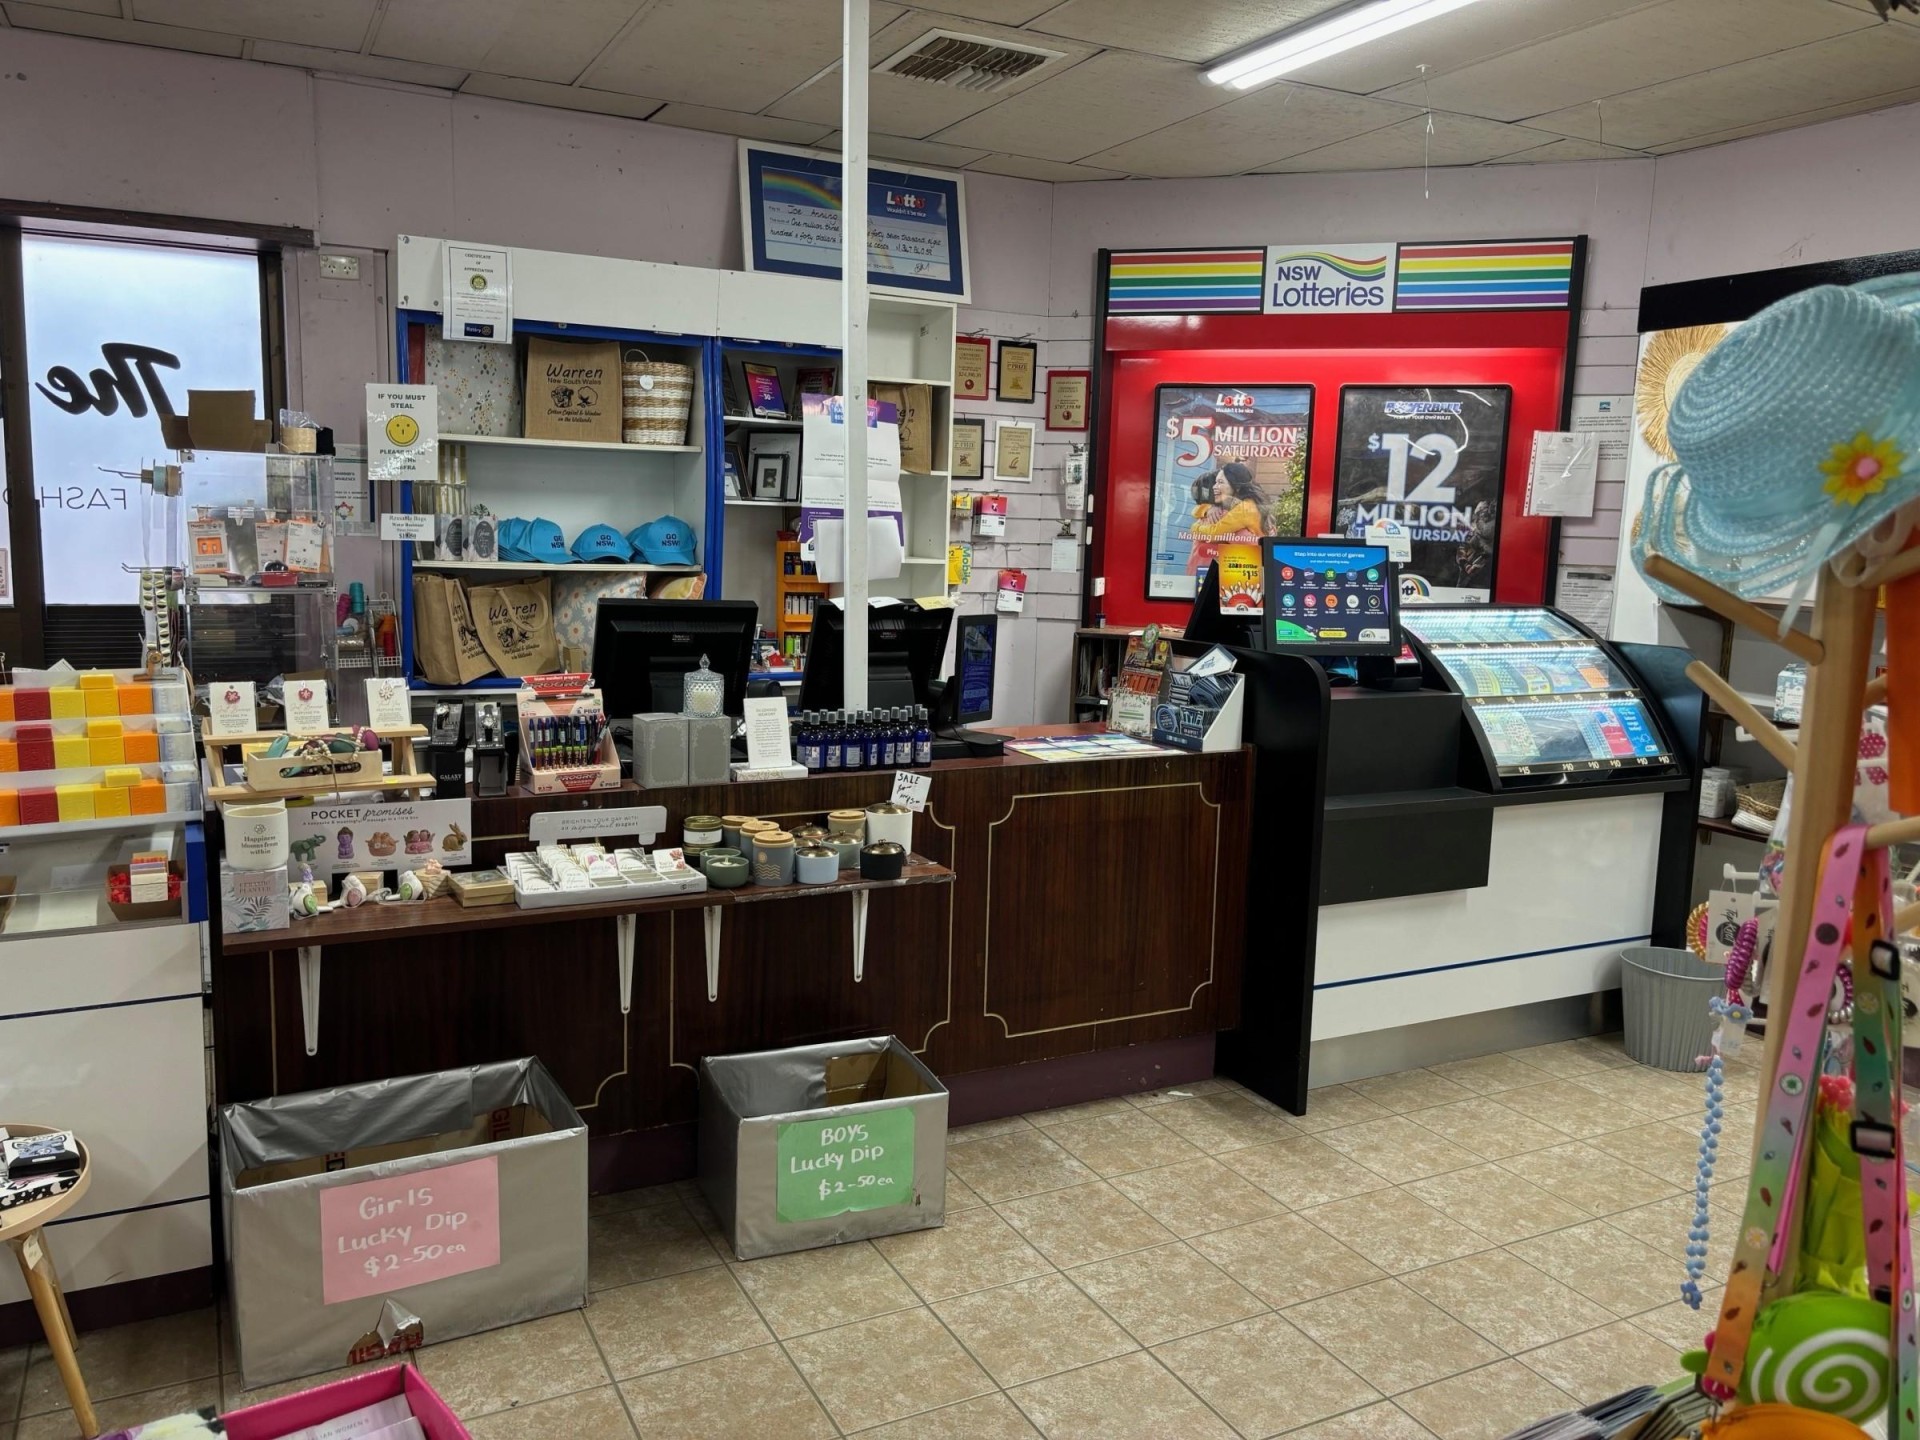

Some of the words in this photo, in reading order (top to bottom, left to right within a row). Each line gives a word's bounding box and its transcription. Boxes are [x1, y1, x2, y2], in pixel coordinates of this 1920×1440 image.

[886, 191, 925, 209] Lotto
[1278, 265, 1322, 281] NSW
[1272, 282, 1384, 307] Lotteries
[546, 363, 603, 379] Warren
[1216, 393, 1255, 407] Lotto
[1384, 401, 1462, 414] POWERBALL
[1166, 416, 1214, 467] $5
[1214, 426, 1297, 444] MILLION
[1214, 445, 1296, 458] SATURDAYS
[1368, 432, 1459, 504] $12
[1356, 503, 1472, 527] MILLION
[1177, 532, 1212, 543] Making
[1411, 528, 1469, 542] URSDAY
[962, 545, 971, 585] Mobile
[1588, 761, 1600, 769] $10
[1610, 760, 1621, 768] $10
[1637, 757, 1648, 765] $10
[1658, 755, 1670, 764] $10
[1518, 766, 1530, 775] $15
[1562, 763, 1574, 771] $10
[897, 772, 920, 785] SALE
[310, 808, 361, 820] POCKET
[362, 806, 415, 821] promises
[244, 835, 276, 843] Happiness
[821, 1124, 869, 1146] BOYS
[791, 1152, 844, 1174] Lucky
[851, 1145, 884, 1164] Dip
[877, 1177, 895, 1186] ea
[359, 1187, 434, 1220] Girls
[338, 1225, 412, 1254] Lucky
[425, 1211, 468, 1231] Dip
[446, 1243, 466, 1254] ea
